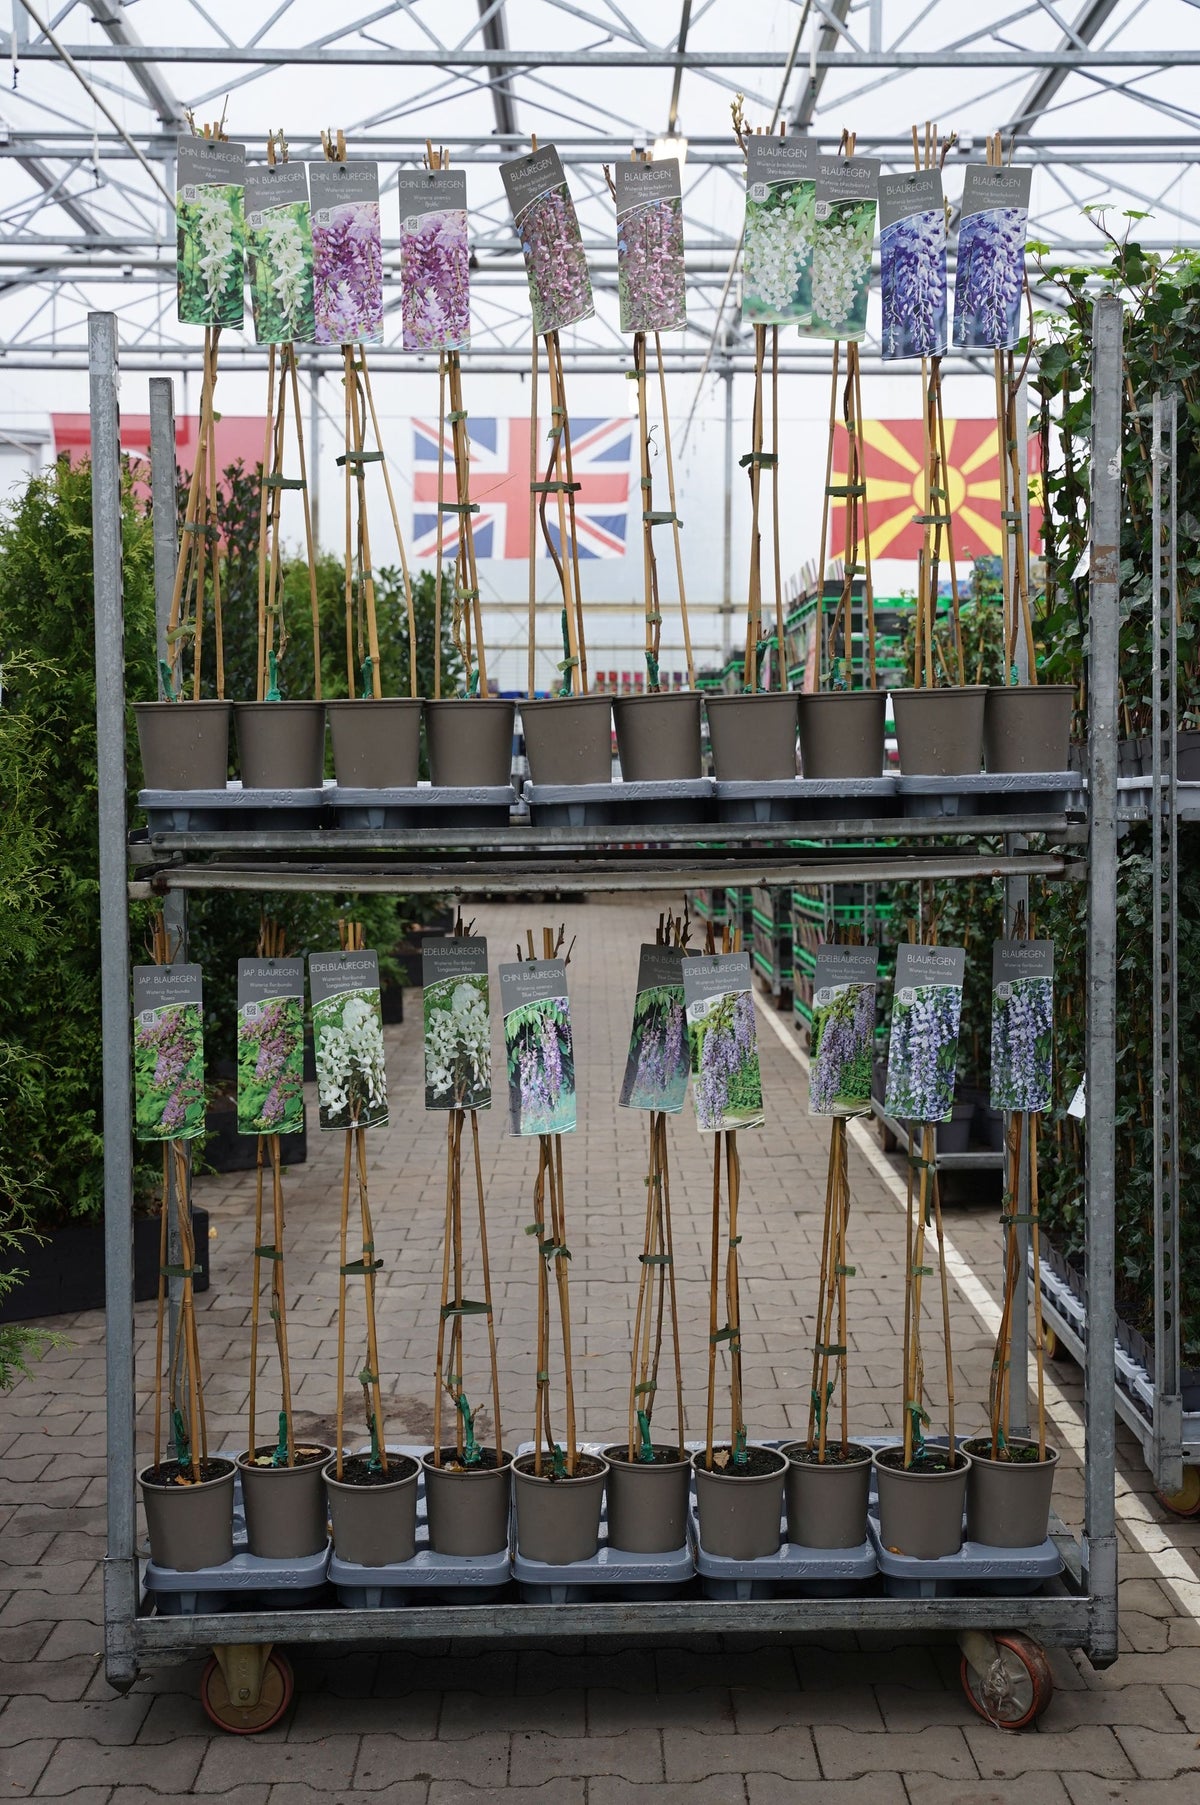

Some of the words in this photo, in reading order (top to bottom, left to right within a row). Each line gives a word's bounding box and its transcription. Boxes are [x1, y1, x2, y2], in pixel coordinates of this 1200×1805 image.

[201, 150, 243, 164] BLAUREGEN
[757, 146, 808, 158] BLAUREGEN
[510, 157, 553, 182] BLAUREGEN
[624, 169, 672, 182] BLAUREGEN
[821, 166, 871, 179] BLAUREGEN
[262, 173, 304, 184] BLAUREGEN
[333, 172, 376, 181] BLAUREGEN
[972, 175, 1021, 187] BLAUREGEN
[400, 180, 420, 189] CHIN.
[421, 180, 464, 189] BLAUREGEN
[886, 180, 934, 195] BLAUREGEN
[423, 947, 485, 956] EDELBLAUREGEN
[1002, 950, 1046, 958] BLAUREGEN
[817, 954, 876, 965] EDELBLAUREGEN
[907, 954, 956, 966] BLAUREGEN
[243, 968, 256, 977] JAP.
[258, 968, 299, 976] BLAUREGEN
[311, 960, 376, 973] EDELBLAUREGEN
[684, 963, 748, 976] EDELBLAUREGEN
[138, 976, 151, 985] JAP.
[154, 975, 197, 984] BLAUREGEN
[523, 970, 565, 981] BLAUREGEN
